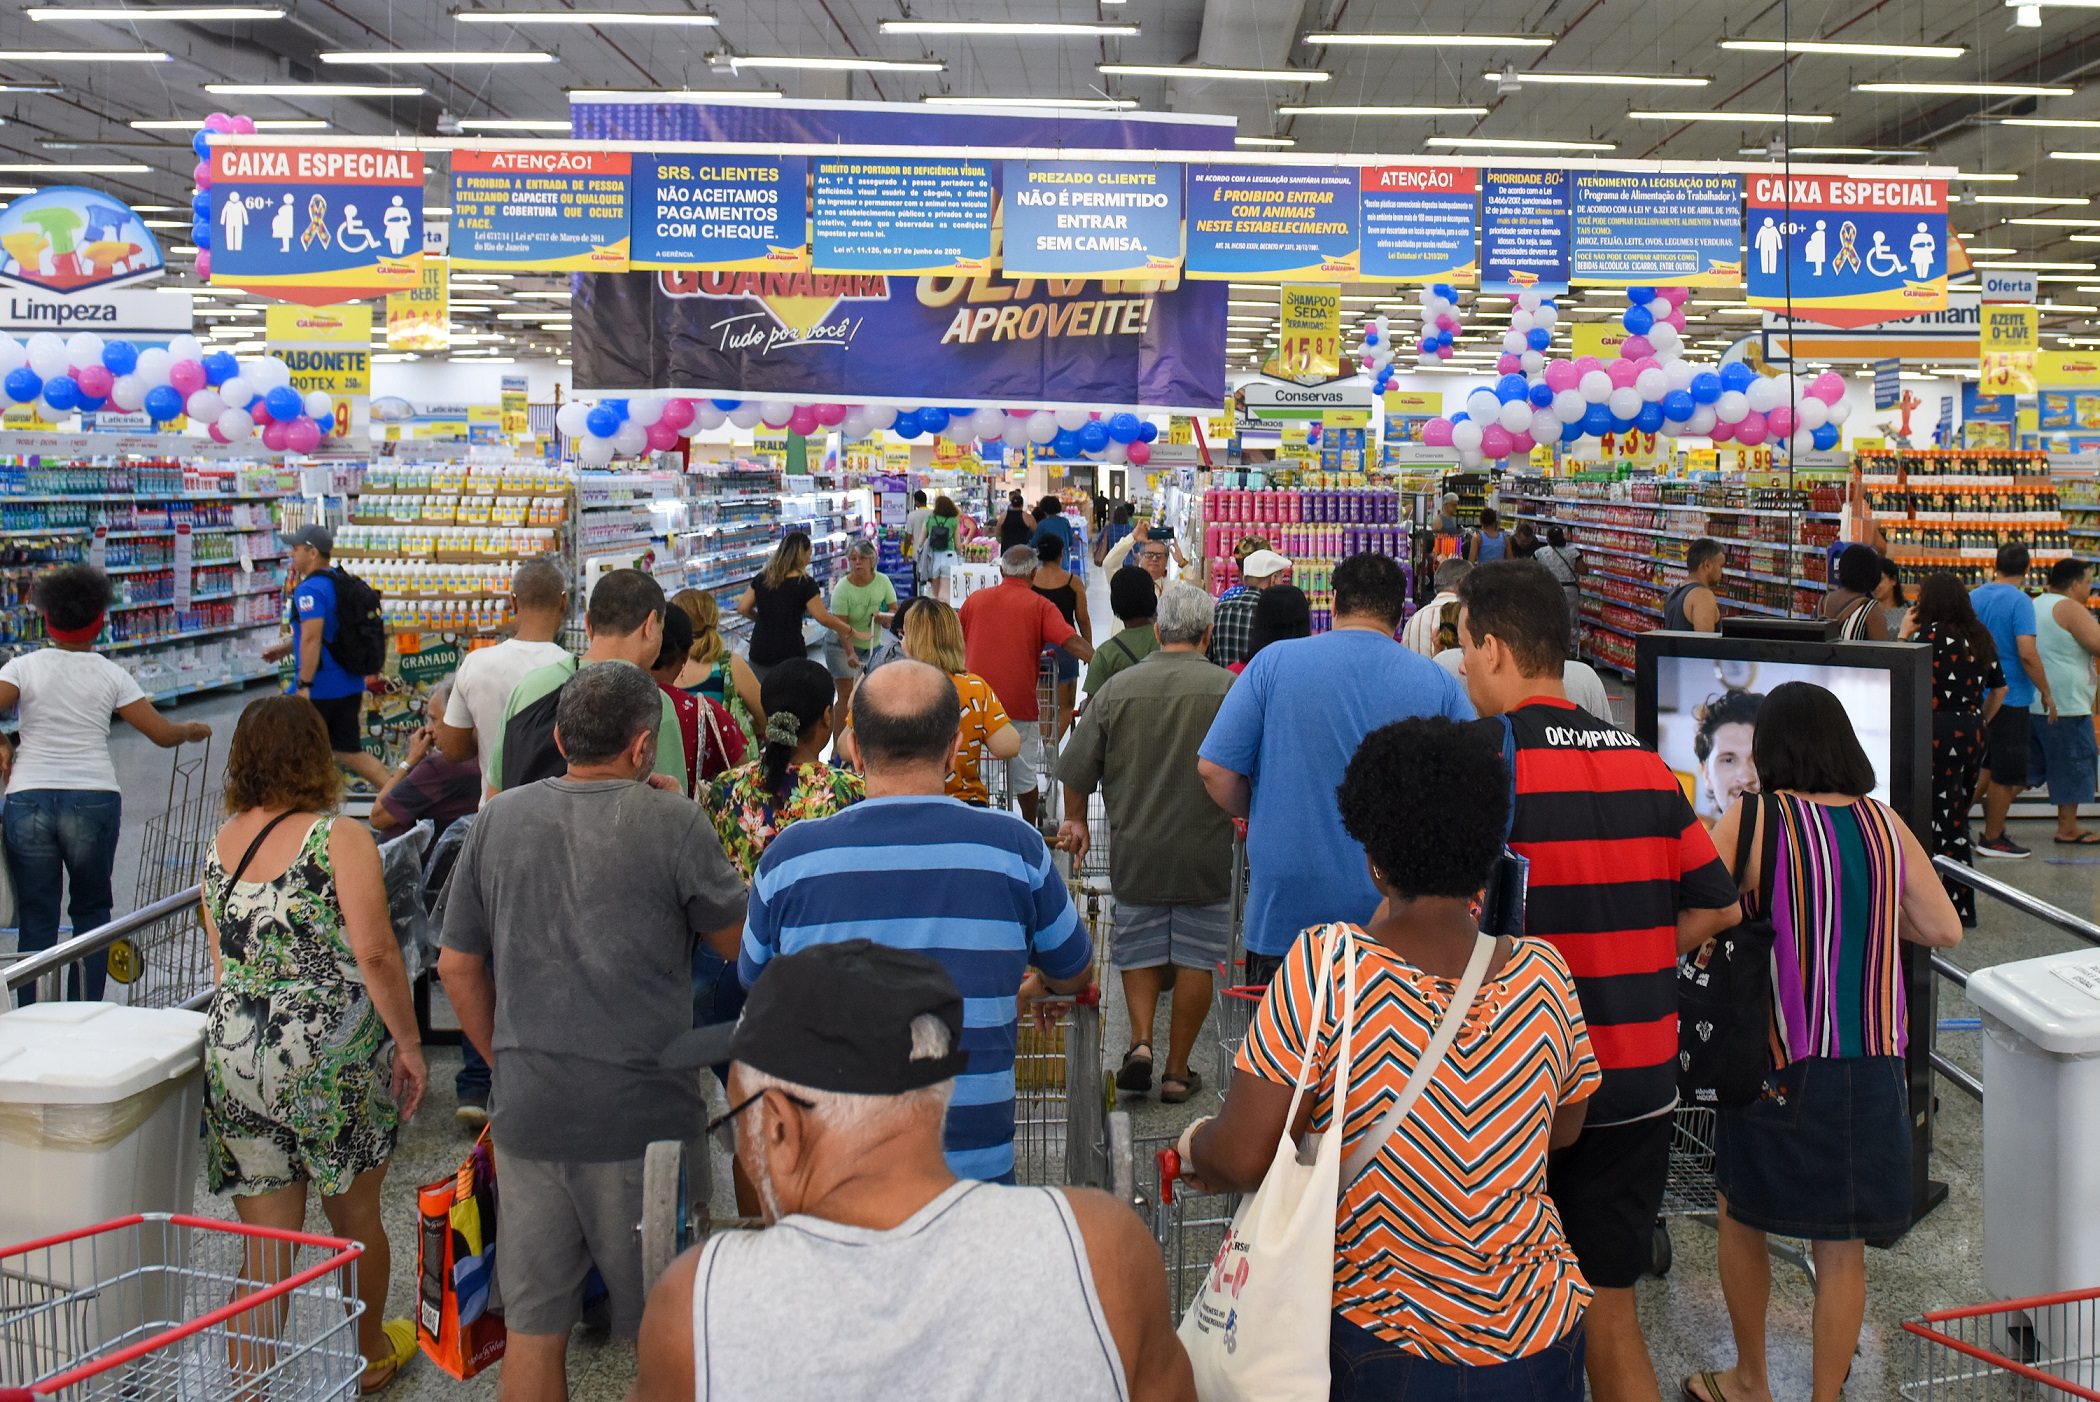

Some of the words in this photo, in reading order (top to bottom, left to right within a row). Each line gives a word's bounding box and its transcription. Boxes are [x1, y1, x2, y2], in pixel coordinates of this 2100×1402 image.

[222, 152, 290, 177] CAIXA
[299, 153, 414, 179] ESPECIAL
[492, 153, 591, 172] ATENÇÃO!
[657, 166, 694, 180] SRS.
[700, 167, 779, 181] CLIENTES
[821, 165, 848, 173] DIREITO
[851, 166, 860, 174] DO
[863, 166, 900, 174] PORTADOR
[903, 167, 911, 175] DE
[914, 165, 958, 175] DEFICIÊNCIA
[961, 167, 985, 176] VISUAL
[457, 176, 462, 188] É
[467, 179, 510, 189] PROIBIDA
[515, 179, 521, 189] A
[526, 179, 567, 190] ENTRADA
[572, 180, 584, 190] DE
[589, 180, 623, 191] PESSOA
[1029, 172, 1092, 184] PREZADO
[1098, 172, 1156, 185] CLIENTE
[1253, 175, 1288, 184] LEGISLAÇÃO
[1289, 176, 1320, 184] SANITÁRIA
[1381, 170, 1452, 190] ATENÇÃO!
[1488, 174, 1542, 184] PRIORIDADE
[1545, 173, 1564, 185] 80+
[1577, 178, 1638, 187] ATENDIMENTO
[1641, 178, 1647, 187] A
[1650, 177, 1702, 190] LEGISLAÇÃO
[1706, 179, 1718, 188] DO
[1722, 179, 1736, 188] PAT
[457, 192, 509, 202] UTILIZANDO
[512, 193, 558, 203] CAPACETE
[560, 194, 573, 204] OU
[576, 194, 623, 205] QUALQUER
[657, 186, 691, 202] NÃO
[693, 188, 778, 203] ACEITAMOS
[1017, 188, 1056, 206] NÃO
[1059, 188, 1068, 206] É
[1073, 192, 1168, 208] PERMITIDO
[1214, 187, 1222, 201] É
[1224, 190, 1284, 202] PROIBIDO
[1287, 191, 1333, 203] ENTRAR
[1585, 189, 1618, 202] Programa
[1621, 190, 1629, 199] de
[1631, 190, 1674, 203] Alimentação
[1676, 190, 1685, 200] do
[1687, 191, 1730, 201] Trabalhador
[1757, 179, 1822, 204] CAIXA
[1830, 181, 1937, 206] ESPECIAL
[246, 196, 274, 210] 60+
[1577, 205, 1585, 213] DE
[1587, 205, 1613, 213] ACORDO
[1653, 206, 1668, 214] 6.321
[457, 205, 477, 215] TIPO
[484, 206, 495, 215] DE
[503, 206, 557, 217] COBERTURA
[564, 207, 582, 218] QUE
[590, 208, 623, 218] OCULTE
[657, 206, 777, 221] PAGAMENTOS
[1232, 206, 1260, 217] COM
[1263, 207, 1315, 218] ANIMAIS
[458, 219, 464, 228] A
[467, 219, 492, 229] FACE.
[1057, 214, 1127, 229] ENTRAR
[1197, 220, 1233, 232] NESTE
[1236, 221, 1348, 234] ESTABELECIMENTO.
[1779, 222, 1806, 235] 60+
[657, 224, 696, 238] COM
[701, 224, 779, 240] CHEQUE.
[1037, 236, 1072, 250] SEM
[1074, 236, 1147, 251] CAMISA.
[1988, 279, 2032, 292] Oferta
[1287, 292, 1335, 307] SHAMPOO
[11, 299, 117, 324] Limpeza
[1294, 306, 1327, 318] SEDA
[941, 299, 1154, 344] APROVEITE!
[1990, 313, 2025, 325] AZEITE
[710, 312, 765, 351] Tudo
[763, 326, 800, 355] por
[807, 316, 863, 350] você!
[1993, 327, 2029, 338] O-LIVE
[1276, 390, 1342, 401] Conservas
[336, 402, 348, 437] 9
[754, 440, 789, 450] FRALD
[402, 651, 456, 669] GRANADO
[1545, 726, 1640, 748] OLYMPIKUS
